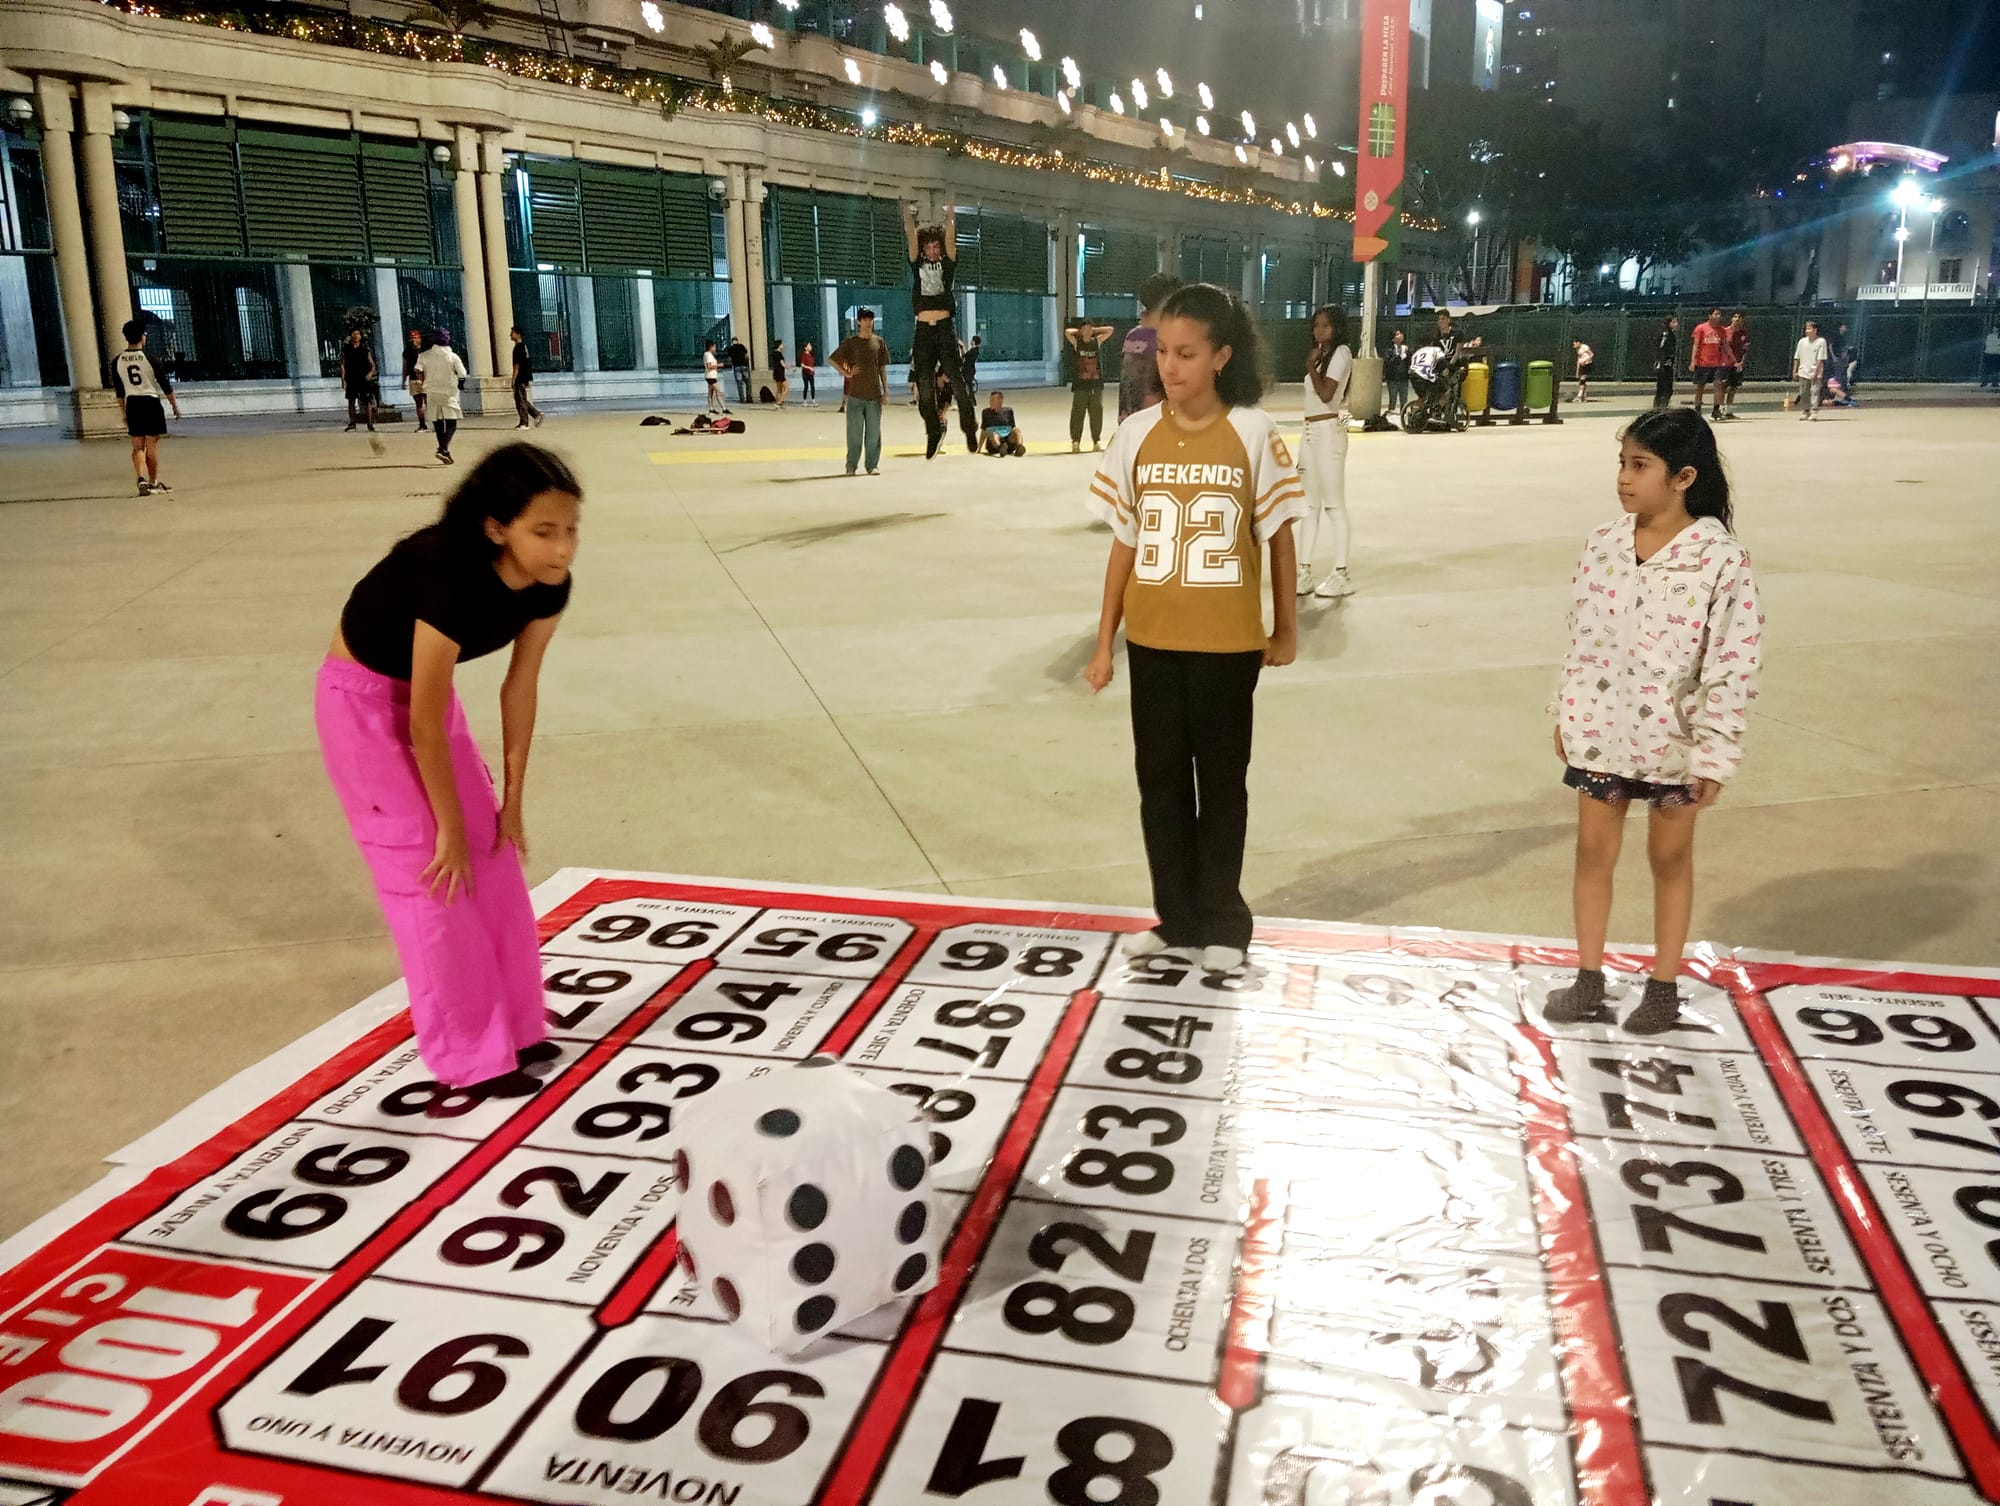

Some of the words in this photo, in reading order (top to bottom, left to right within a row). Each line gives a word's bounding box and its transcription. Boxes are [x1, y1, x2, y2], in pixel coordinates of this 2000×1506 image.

[127, 365, 143, 386] 6
[1137, 463, 1244, 488] WEEKENDS
[1134, 490, 1243, 588] 82
[577, 915, 720, 950] 96
[740, 927, 888, 962] 95
[829, 917, 896, 929] NOVENTA
[938, 940, 1085, 978] 86
[672, 981, 803, 1044] 94
[884, 988, 926, 1028] OCHENTA
[1818, 992, 1852, 1002] SEIS
[1872, 994, 1945, 1008] SESENTA
[859, 1035, 890, 1061] SIETE
[913, 999, 1027, 1069] 87
[1105, 1014, 1214, 1085] 84
[1796, 1006, 1977, 1053] 66
[322, 1085, 371, 1115] OCHO
[573, 1061, 721, 1143] 93
[1589, 1056, 1717, 1131] 74
[225, 1127, 315, 1183] NOVENTA
[1063, 1104, 1188, 1196] 83
[1199, 1149, 1230, 1204] OCHENTA
[1760, 1158, 1796, 1194] TRES
[148, 1193, 220, 1239] NUEVE
[436, 1165, 632, 1273] 92
[565, 1216, 644, 1284] NOVENTA
[640, 1176, 680, 1202] DOS
[1620, 1158, 1769, 1254] 73
[1784, 1207, 1835, 1276] SETENTA
[1923, 1243, 1969, 1289] OCHO
[1003, 1221, 1156, 1346] 82
[1164, 1280, 1201, 1352] OCHENTA
[1186, 1237, 1210, 1265] DOS
[1822, 1294, 1862, 1340] DOS
[0, 1286, 264, 1443] 100
[279, 1317, 532, 1419] 91
[1658, 1293, 1836, 1426] 72
[246, 1415, 312, 1437] UNO
[572, 1355, 827, 1466] 90
[1851, 1362, 1924, 1462] SETENTA
[339, 1426, 475, 1466] NOVENTA
[922, 1397, 1174, 1506] 81
[544, 1451, 744, 1506] NOVENTA
